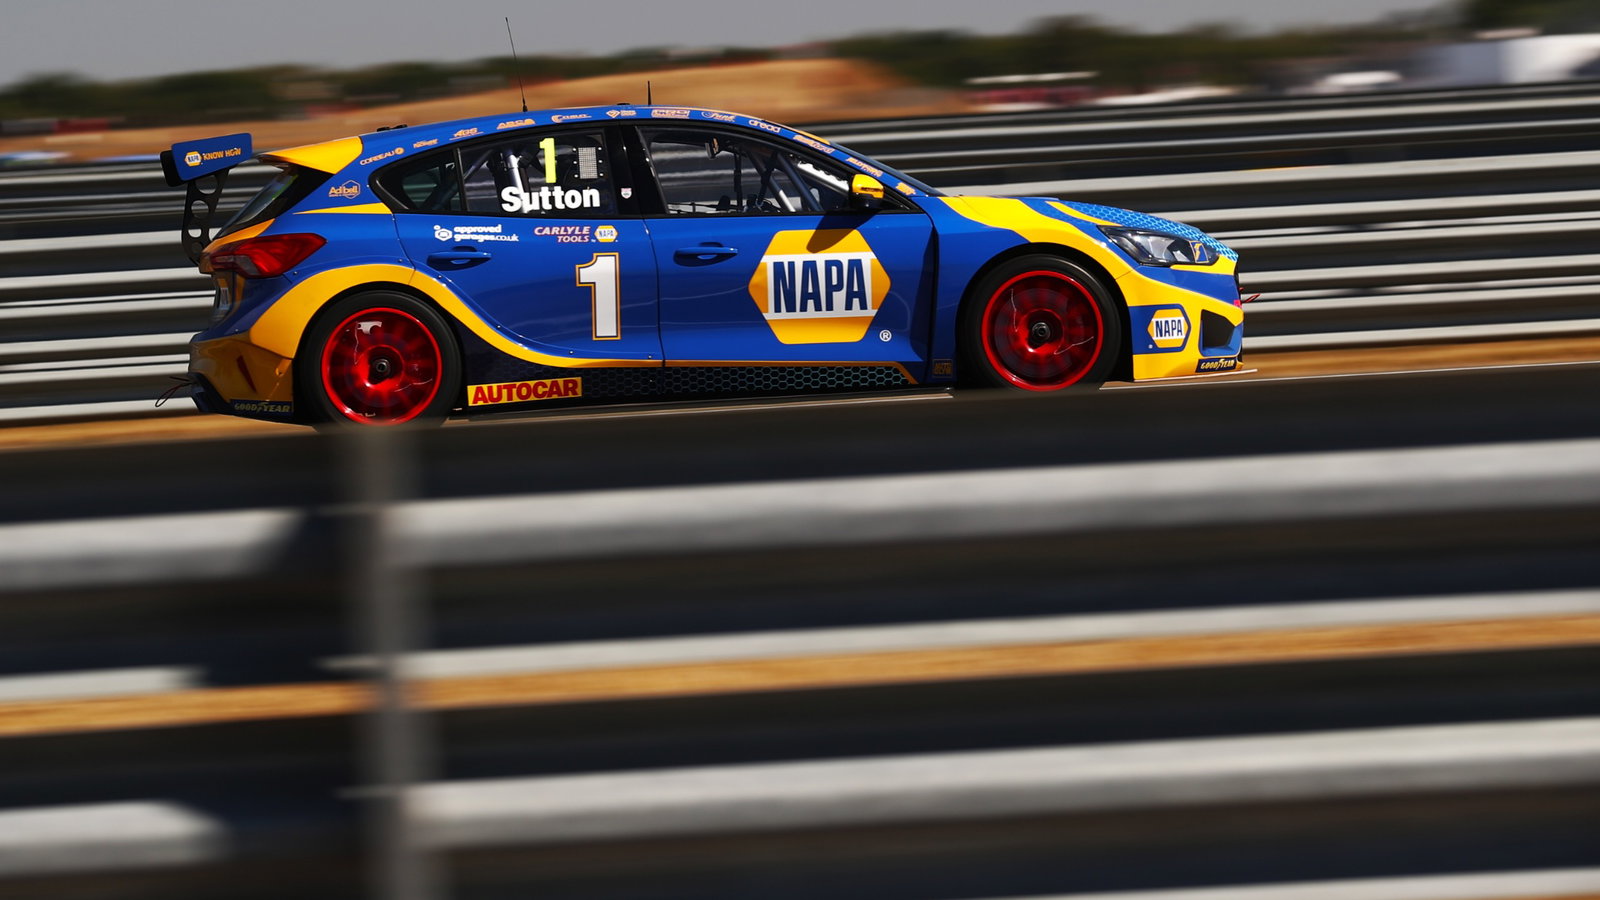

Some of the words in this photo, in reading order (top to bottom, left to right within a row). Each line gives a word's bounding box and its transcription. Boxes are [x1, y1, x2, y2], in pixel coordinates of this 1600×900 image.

[203, 150, 224, 160] KNOW
[539, 137, 557, 184] 1
[501, 186, 601, 213] Sutton
[453, 224, 502, 234] approved
[534, 226, 591, 236] CARLYLE
[598, 230, 614, 238] NAPA
[557, 235, 590, 243] TOOLS
[773, 258, 868, 313] NAPA
[576, 252, 621, 341] 1
[1155, 319, 1183, 338] NAPA
[472, 379, 579, 405] AUTOCAR
